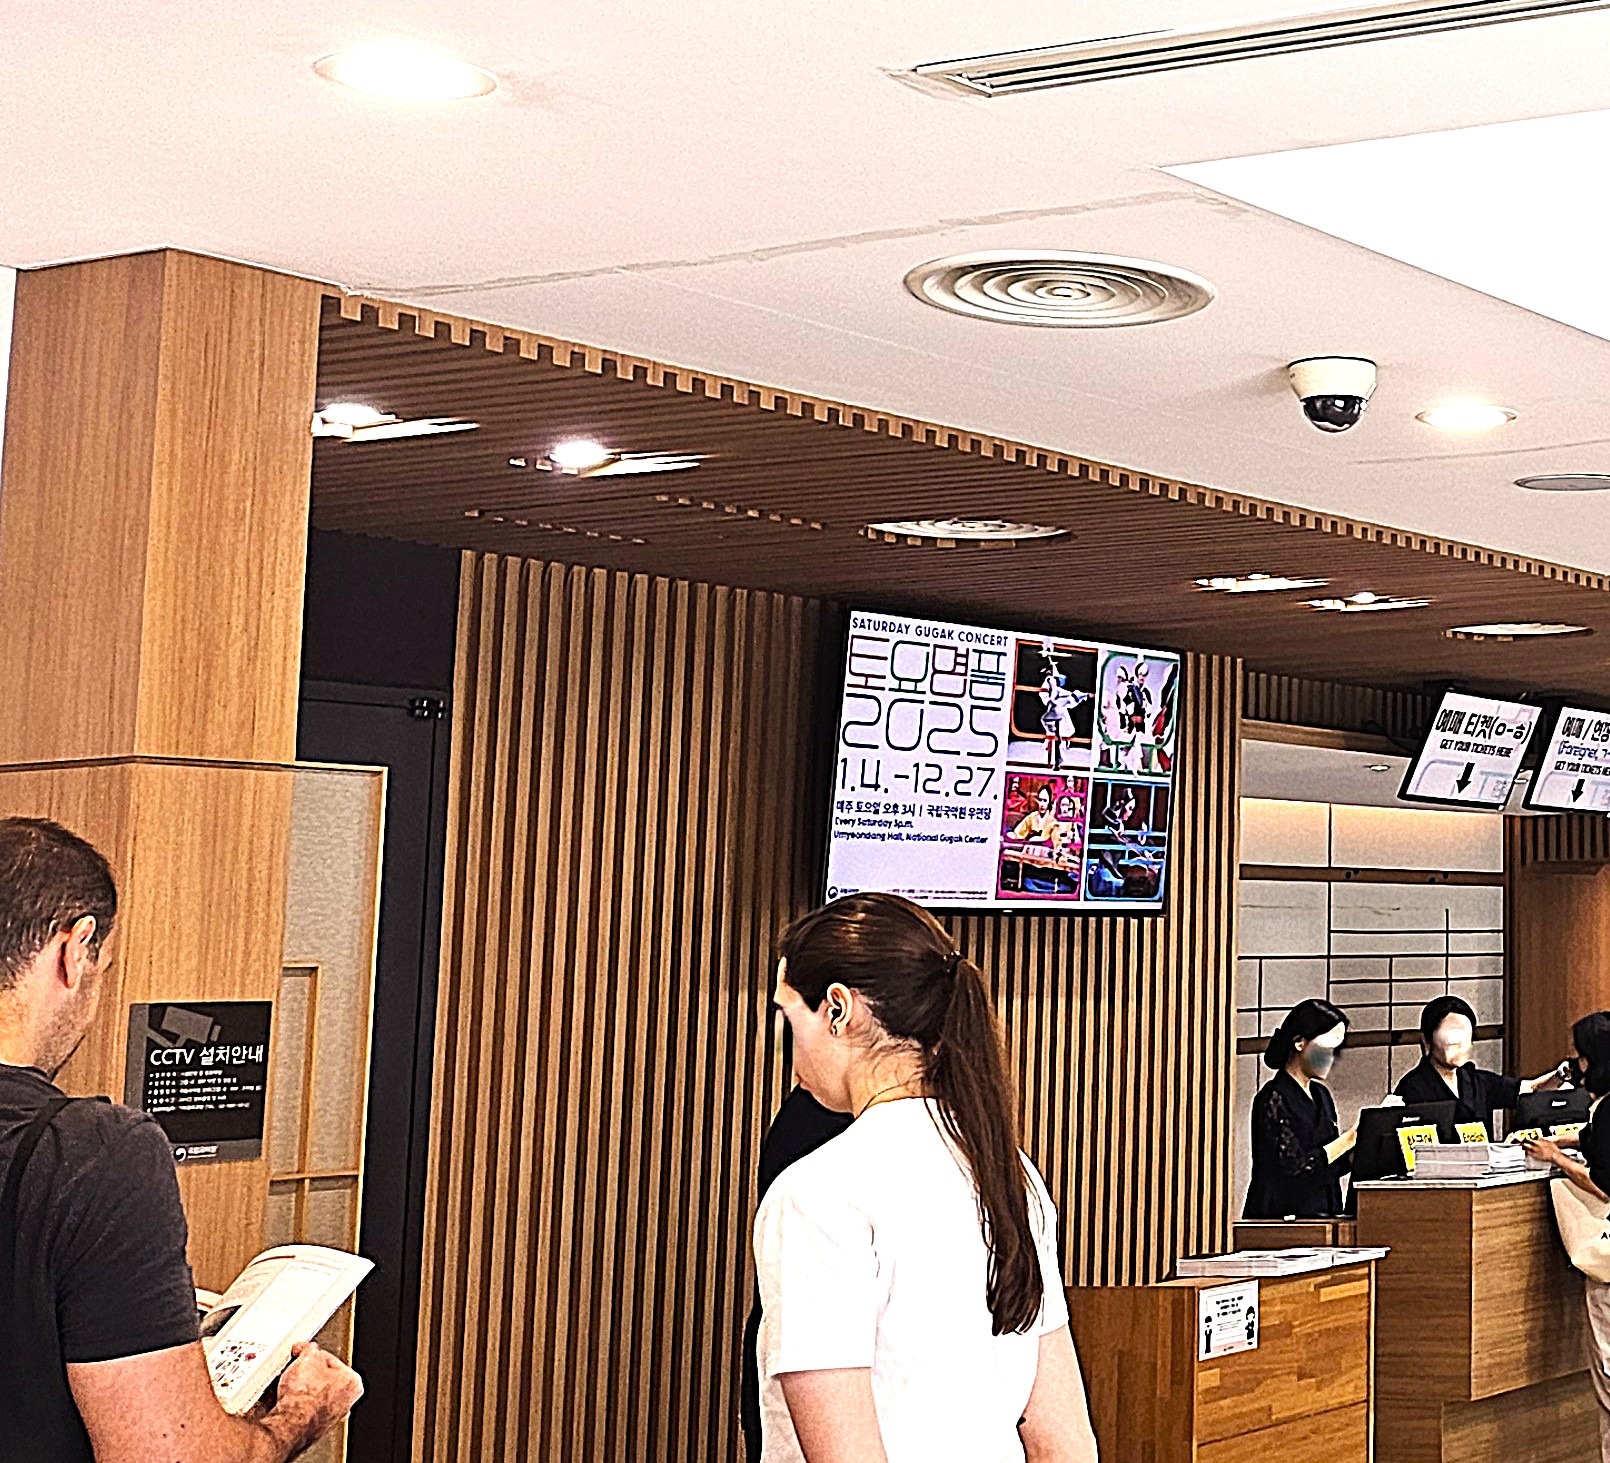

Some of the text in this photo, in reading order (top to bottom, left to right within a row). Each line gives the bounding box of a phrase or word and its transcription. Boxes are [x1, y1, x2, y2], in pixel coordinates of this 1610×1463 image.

[852, 617, 1009, 647] SATURDAY GUGAK CONCERT
[846, 634, 1008, 702] 토요명품
[842, 692, 1002, 758] 2025
[1435, 708, 1466, 735] 예매
[1439, 738, 1513, 758] GET YOUR TICKETS HERE
[855, 801, 881, 814] 토요일
[882, 802, 899, 815] 오후
[901, 803, 915, 817] 3시
[857, 818, 893, 829] Saturday
[906, 832, 939, 842] National
[150, 1044, 264, 1066] CCTV 설치안내
